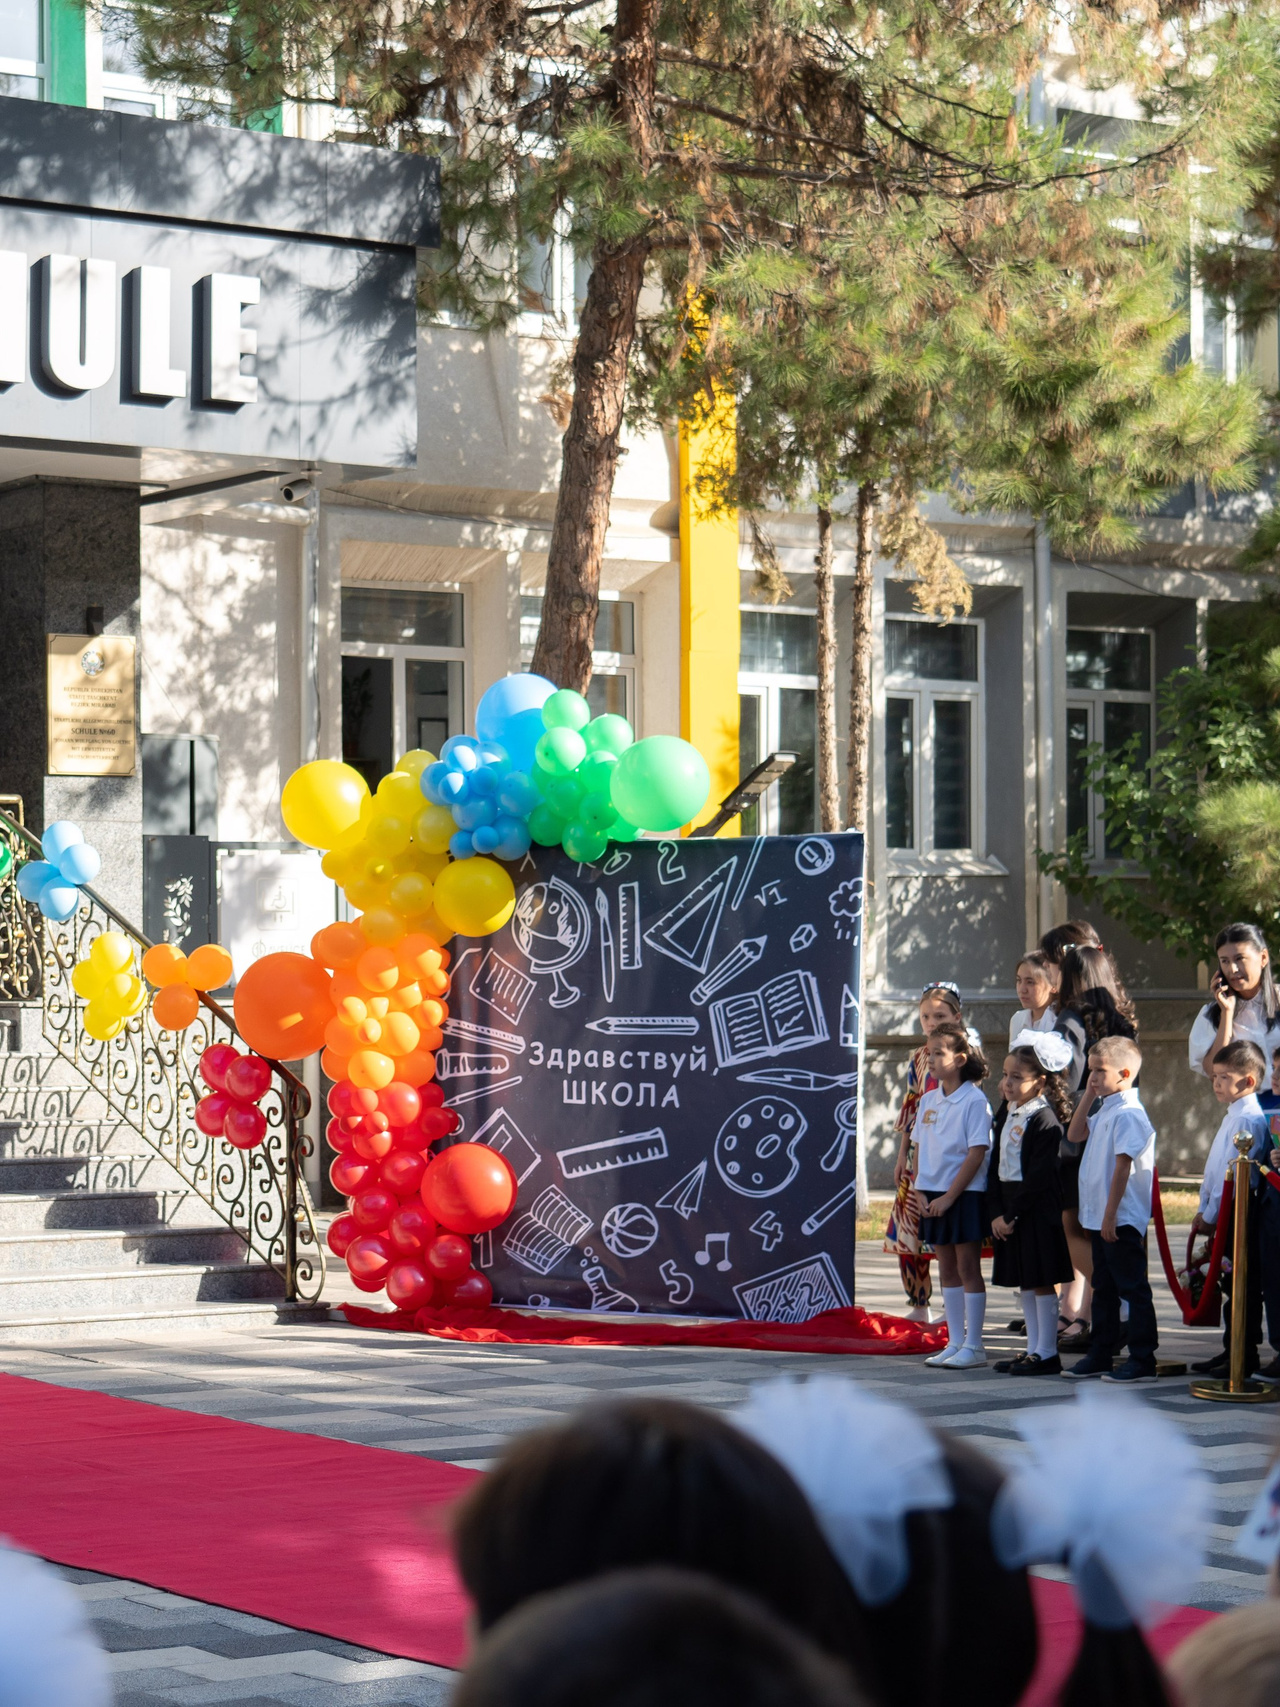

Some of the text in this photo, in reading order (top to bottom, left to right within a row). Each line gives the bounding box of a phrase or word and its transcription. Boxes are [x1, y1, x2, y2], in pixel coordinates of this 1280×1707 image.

[657, 841, 686, 885] 2
[528, 1041, 719, 1078] Здравствуй,
[562, 1079, 680, 1109] ШКОЛА
[749, 1210, 784, 1252] 4
[659, 1259, 694, 1305] 5
